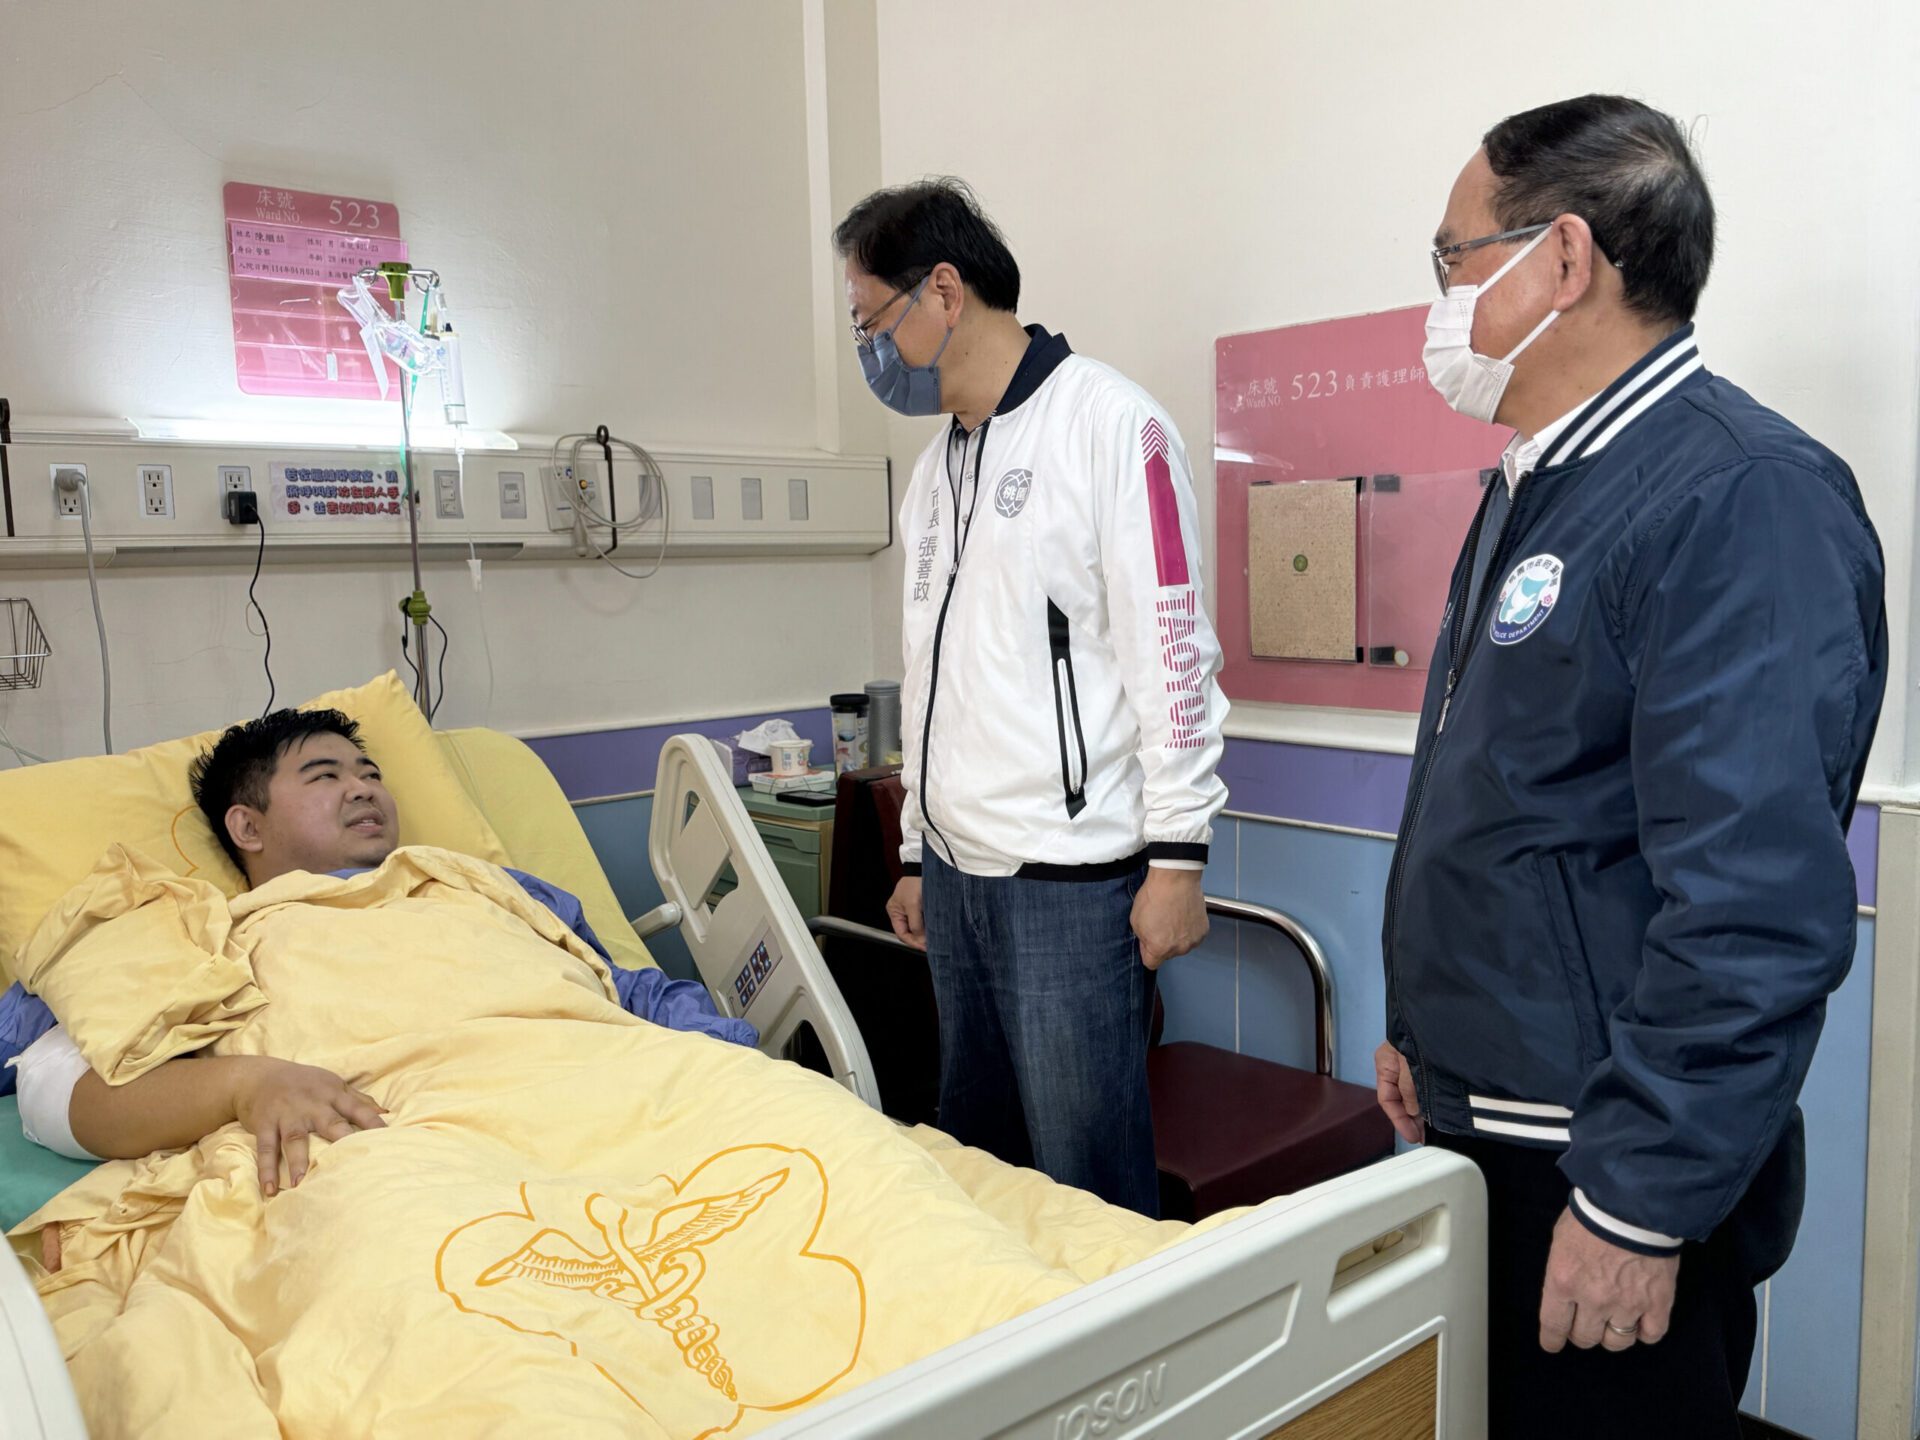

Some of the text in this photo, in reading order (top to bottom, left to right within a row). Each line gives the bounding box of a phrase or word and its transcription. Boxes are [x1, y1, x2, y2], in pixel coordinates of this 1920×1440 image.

[255, 207, 280, 220] Ward
[256, 188, 380, 229] 床號 523
[1248, 365, 1425, 400] 床號 523 負責護理師
[1246, 396, 1266, 408] Ward
[913, 535, 938, 602] 張善政
